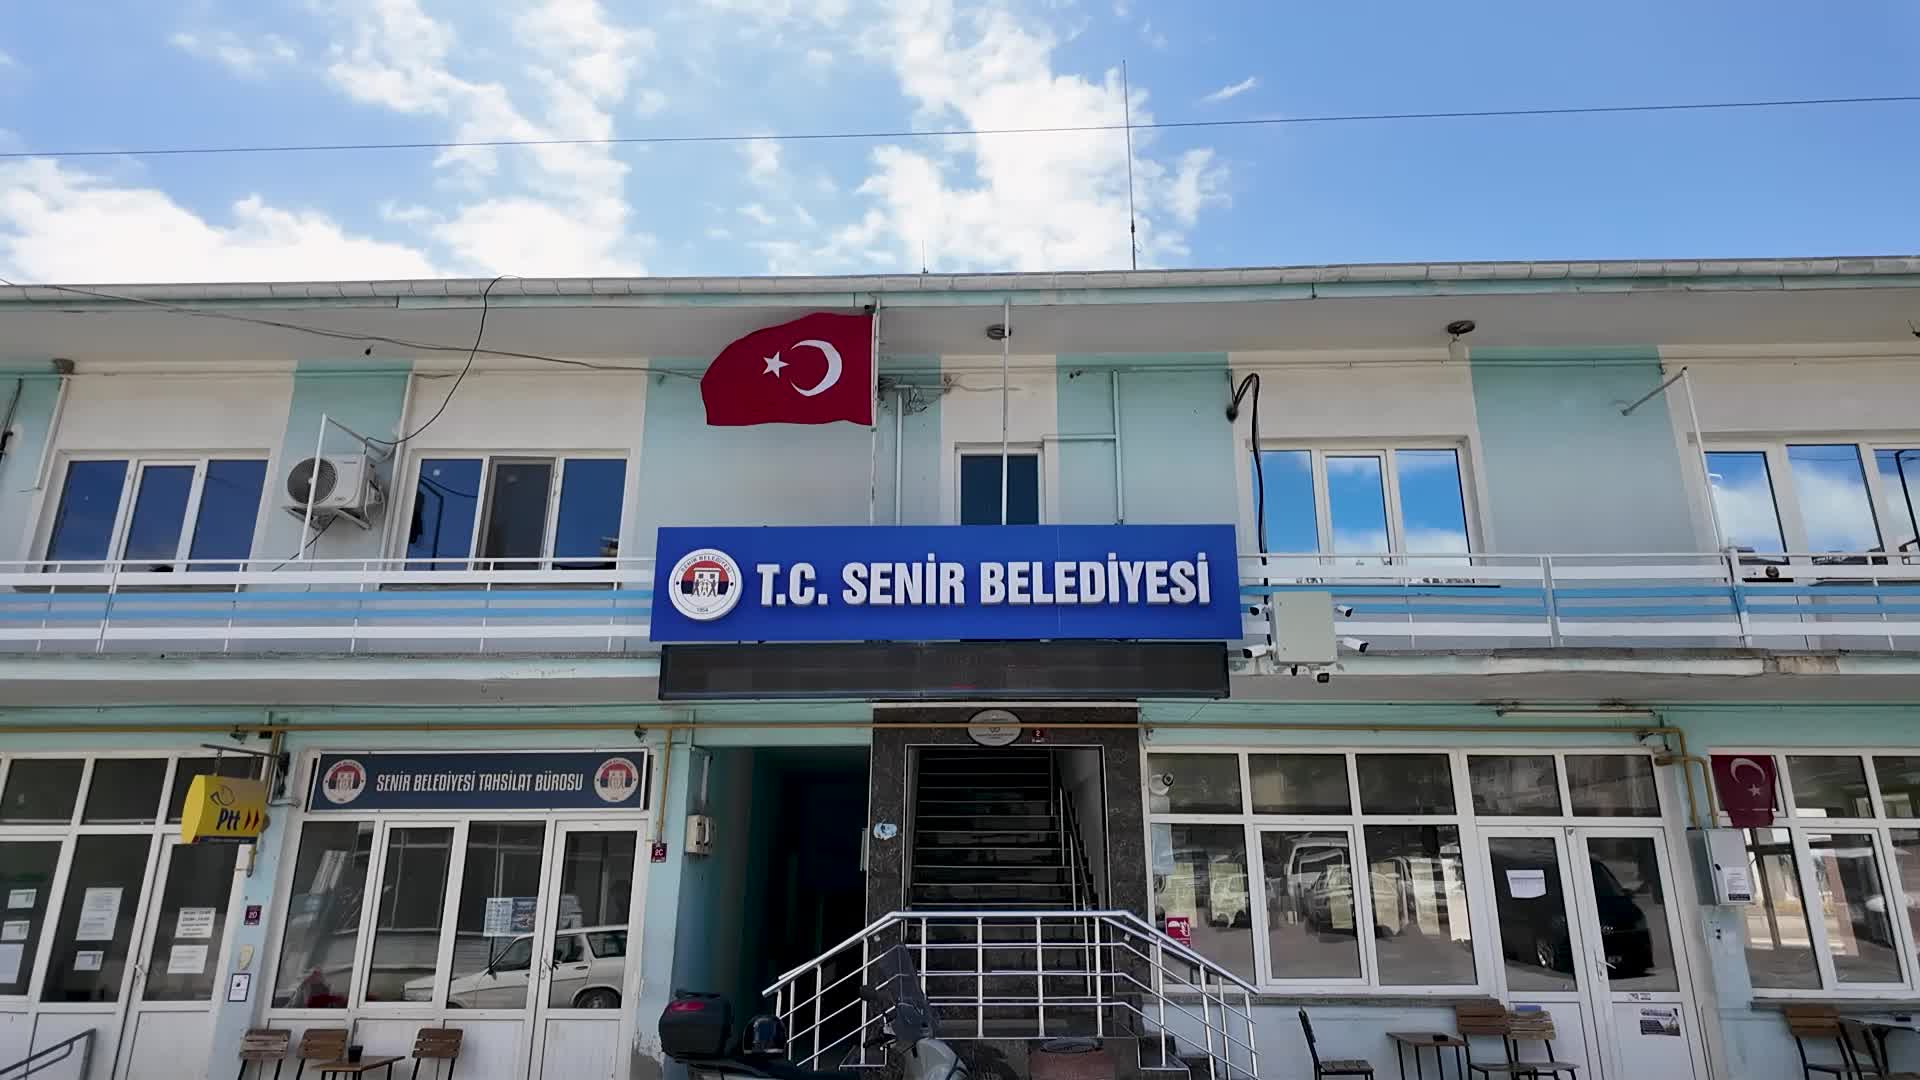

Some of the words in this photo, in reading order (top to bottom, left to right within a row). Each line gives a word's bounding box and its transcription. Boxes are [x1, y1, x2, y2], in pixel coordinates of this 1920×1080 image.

[757, 562, 829, 606] T.C.
[842, 553, 966, 606] SENİR
[980, 552, 1211, 606] BELEDİYESİ
[376, 770, 411, 792] SENİR
[413, 770, 476, 792] BELEDİYESİ
[479, 769, 533, 792] TAHSİLAT
[535, 769, 584, 792] BÜROSU
[216, 808, 241, 831] Ptt
[654, 848, 664, 857] 2C
